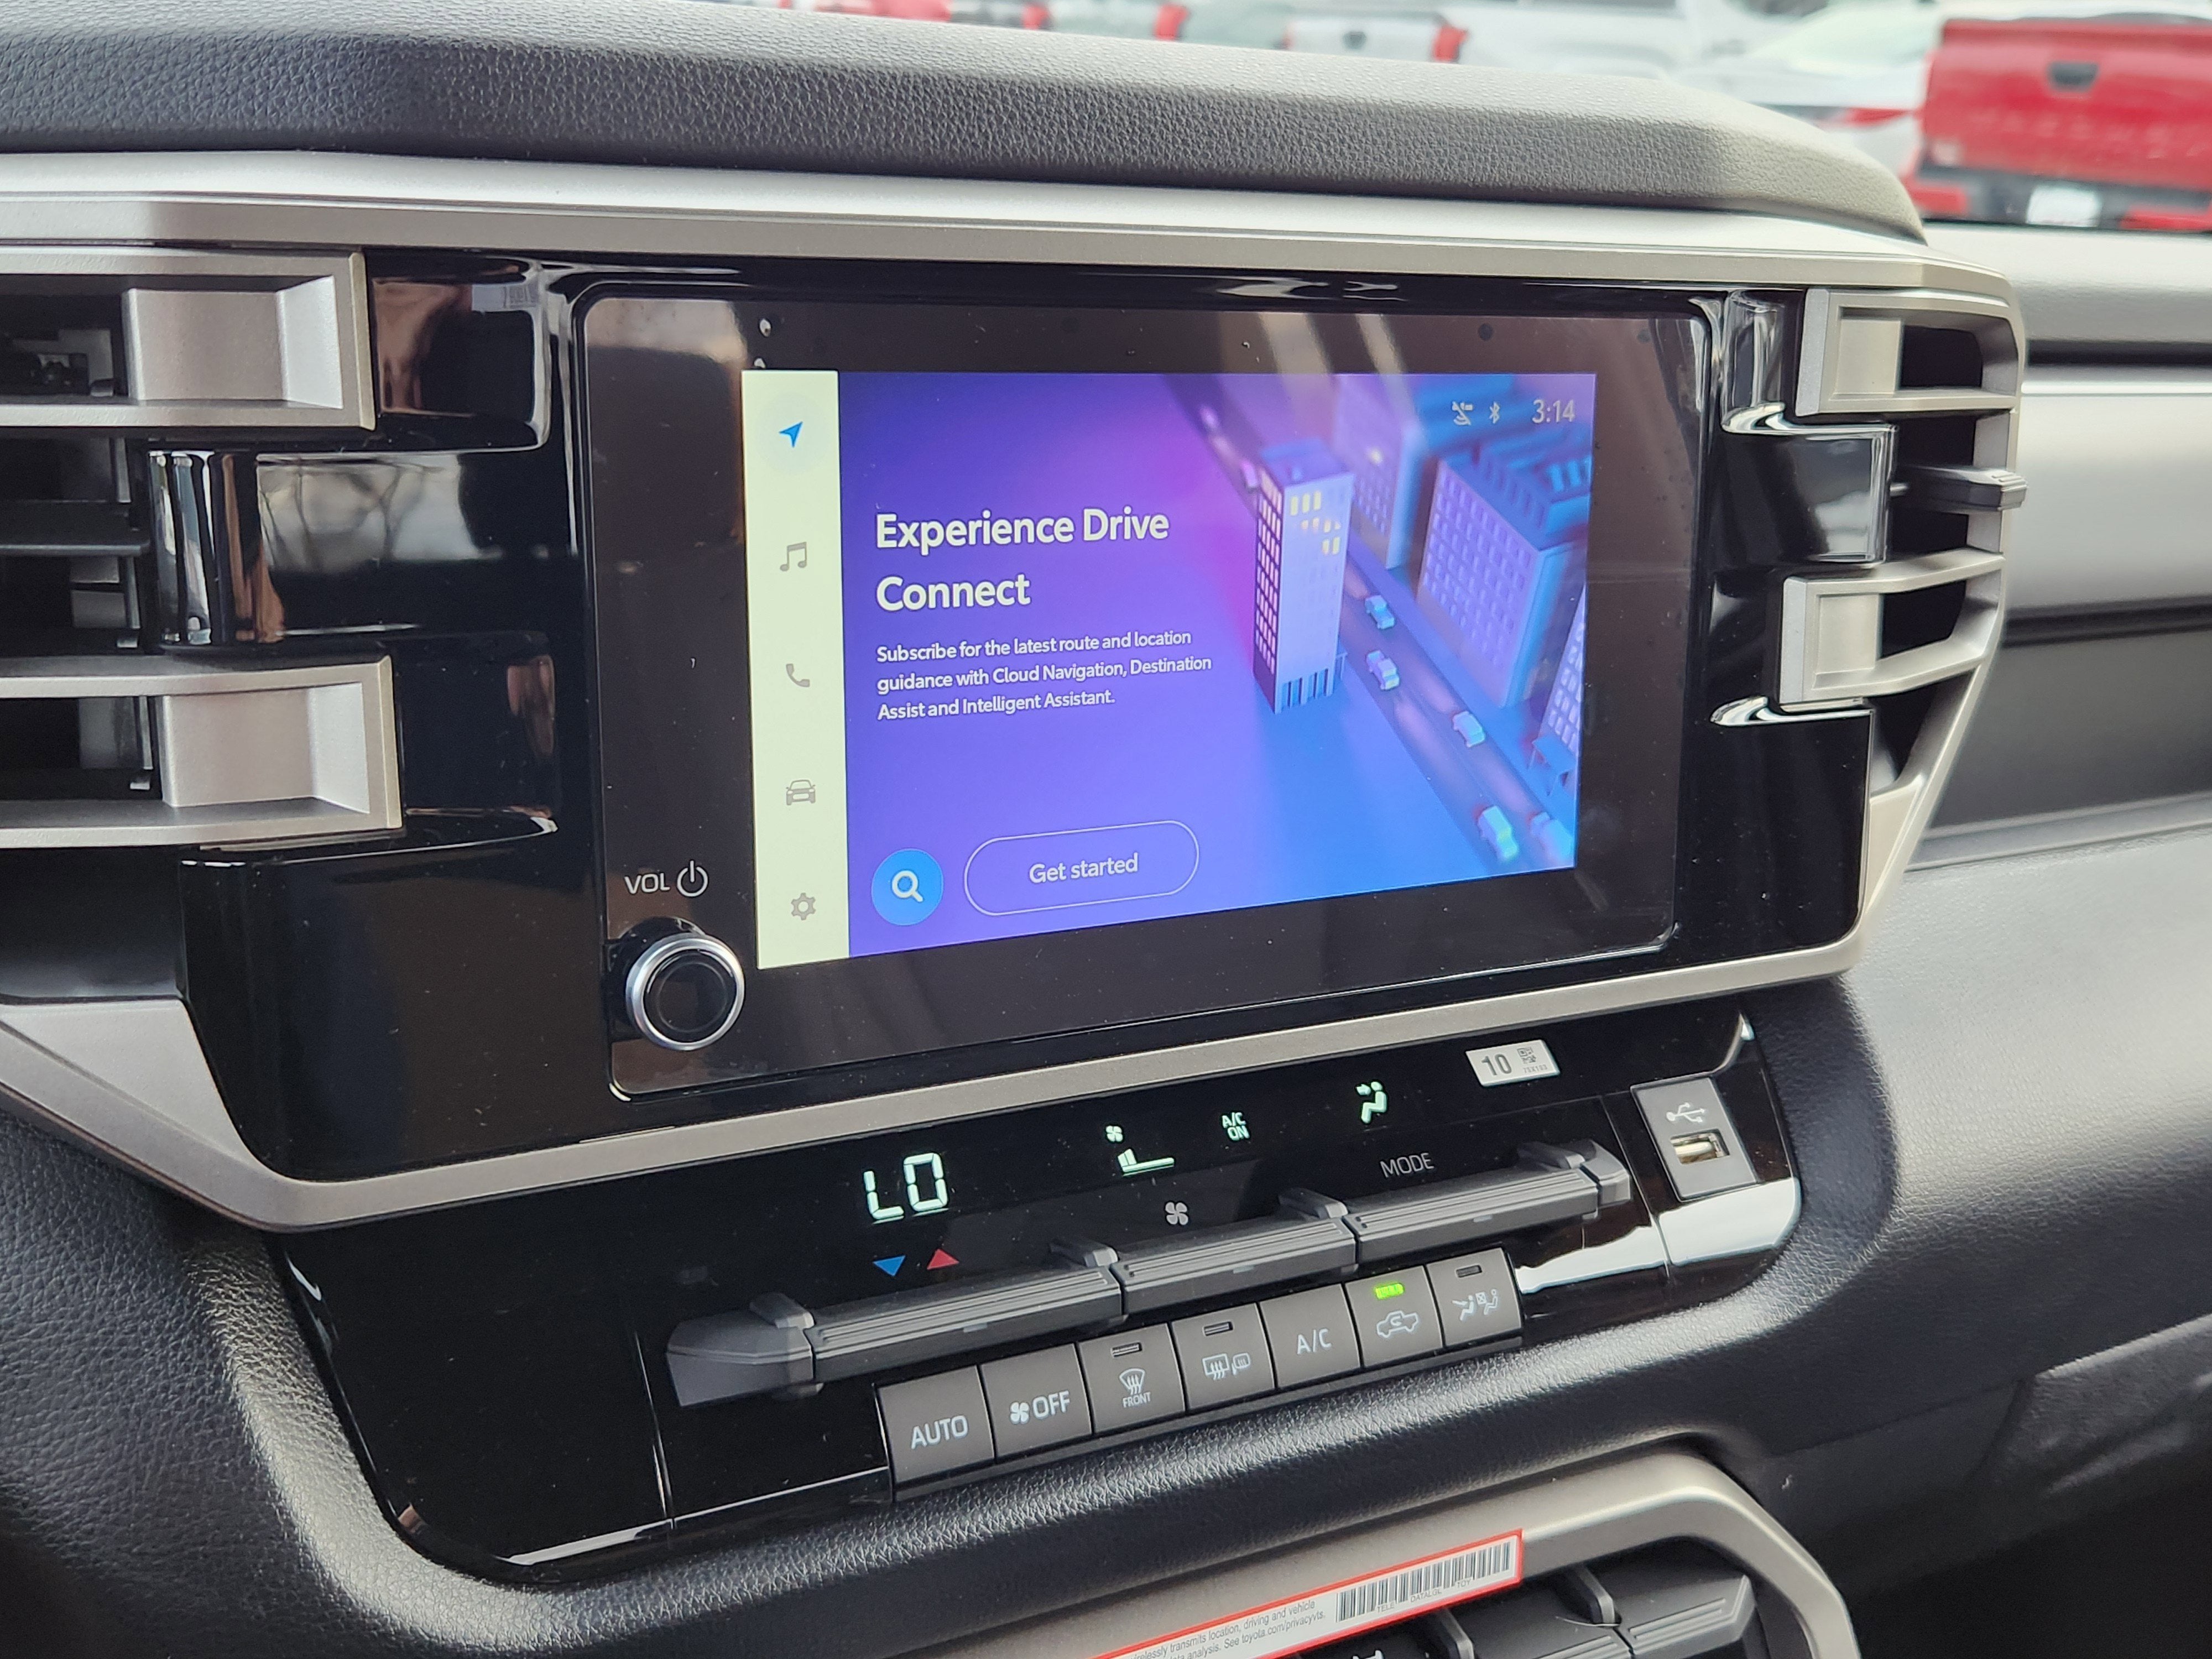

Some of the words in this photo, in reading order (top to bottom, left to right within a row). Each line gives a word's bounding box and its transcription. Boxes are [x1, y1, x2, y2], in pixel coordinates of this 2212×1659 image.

[1532, 399, 1575, 424] 3:14
[877, 510, 1073, 555] Experience
[1083, 505, 1169, 543] Drive
[877, 574, 1031, 612] Connect
[877, 643, 957, 662] Subscribe
[959, 641, 982, 658] for
[985, 639, 1010, 656] the
[1014, 638, 1057, 654] latest
[1059, 635, 1099, 651] route
[1102, 632, 1131, 649] and
[1135, 630, 1191, 646] location
[877, 673, 952, 695] guidance
[956, 669, 989, 686] with
[993, 665, 1039, 683] Cloud
[1043, 661, 1127, 682] Navigation,
[1130, 656, 1212, 675] Destination
[878, 702, 925, 720] Assist
[928, 698, 959, 717] and
[963, 695, 1041, 714] Intelligent
[1044, 690, 1115, 708] Assistant.
[1029, 862, 1066, 884] Get
[1071, 852, 1139, 879] started
[624, 873, 670, 894] VOL
[1481, 1053, 1512, 1076] 10
[1222, 1112, 1246, 1128] A/C
[1228, 1125, 1250, 1140] ON
[1380, 1152, 1434, 1178] MODE
[863, 1152, 948, 1220] LO
[1297, 1328, 1332, 1354] A/C
[1032, 1390, 1070, 1419] OFF
[1123, 1392, 1151, 1408] FRONT
[911, 1415, 968, 1449] AUTO
[1457, 1579, 1472, 1588] TOY
[1128, 1646, 1168, 1659] irelessly
[1170, 1634, 1207, 1653] transmits
[1208, 1625, 1241, 1641] location,
[1244, 1615, 1269, 1630] driving
[1271, 1608, 1286, 1621] and
[1288, 1600, 1315, 1615] vehicle
[1224, 1637, 1239, 1649] See
